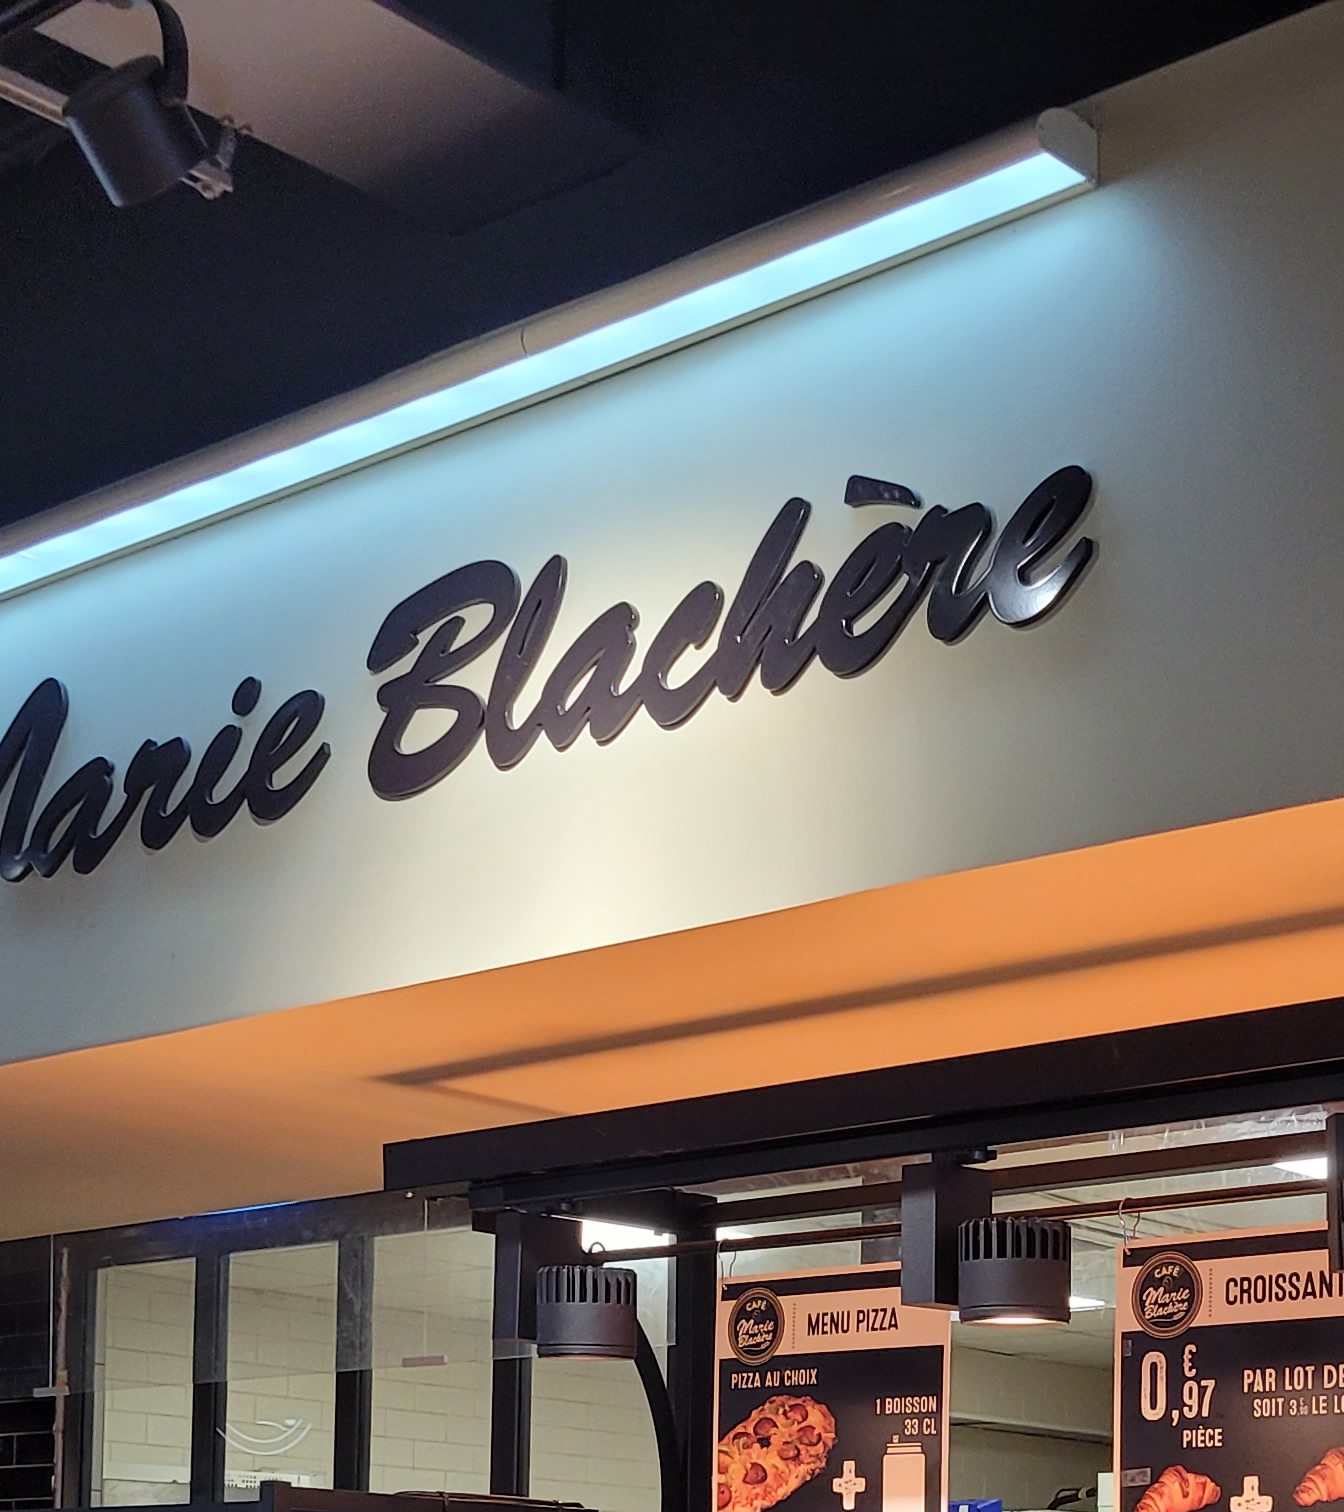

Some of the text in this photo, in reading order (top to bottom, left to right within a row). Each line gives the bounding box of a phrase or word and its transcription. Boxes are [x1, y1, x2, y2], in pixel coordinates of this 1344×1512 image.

[366, 464, 1099, 800] Blachère
[1154, 1264, 1180, 1278] CAFÉ
[1142, 1286, 1191, 1307] Marie
[1143, 1301, 1189, 1320] Blachère
[737, 1318, 775, 1338] Marie
[807, 1307, 899, 1336] MENU PIZZA
[731, 1368, 818, 1389] PIZZA AU CHOIX
[1242, 1368, 1277, 1394] PAR
[1284, 1366, 1315, 1391] LOT
[875, 1395, 937, 1415] 1 BOISSON
[1253, 1398, 1284, 1418] SOIT
[1311, 1396, 1328, 1415] LE
[904, 1417, 937, 1435] 33 CL
[1182, 1425, 1223, 1449] PIÈCE
